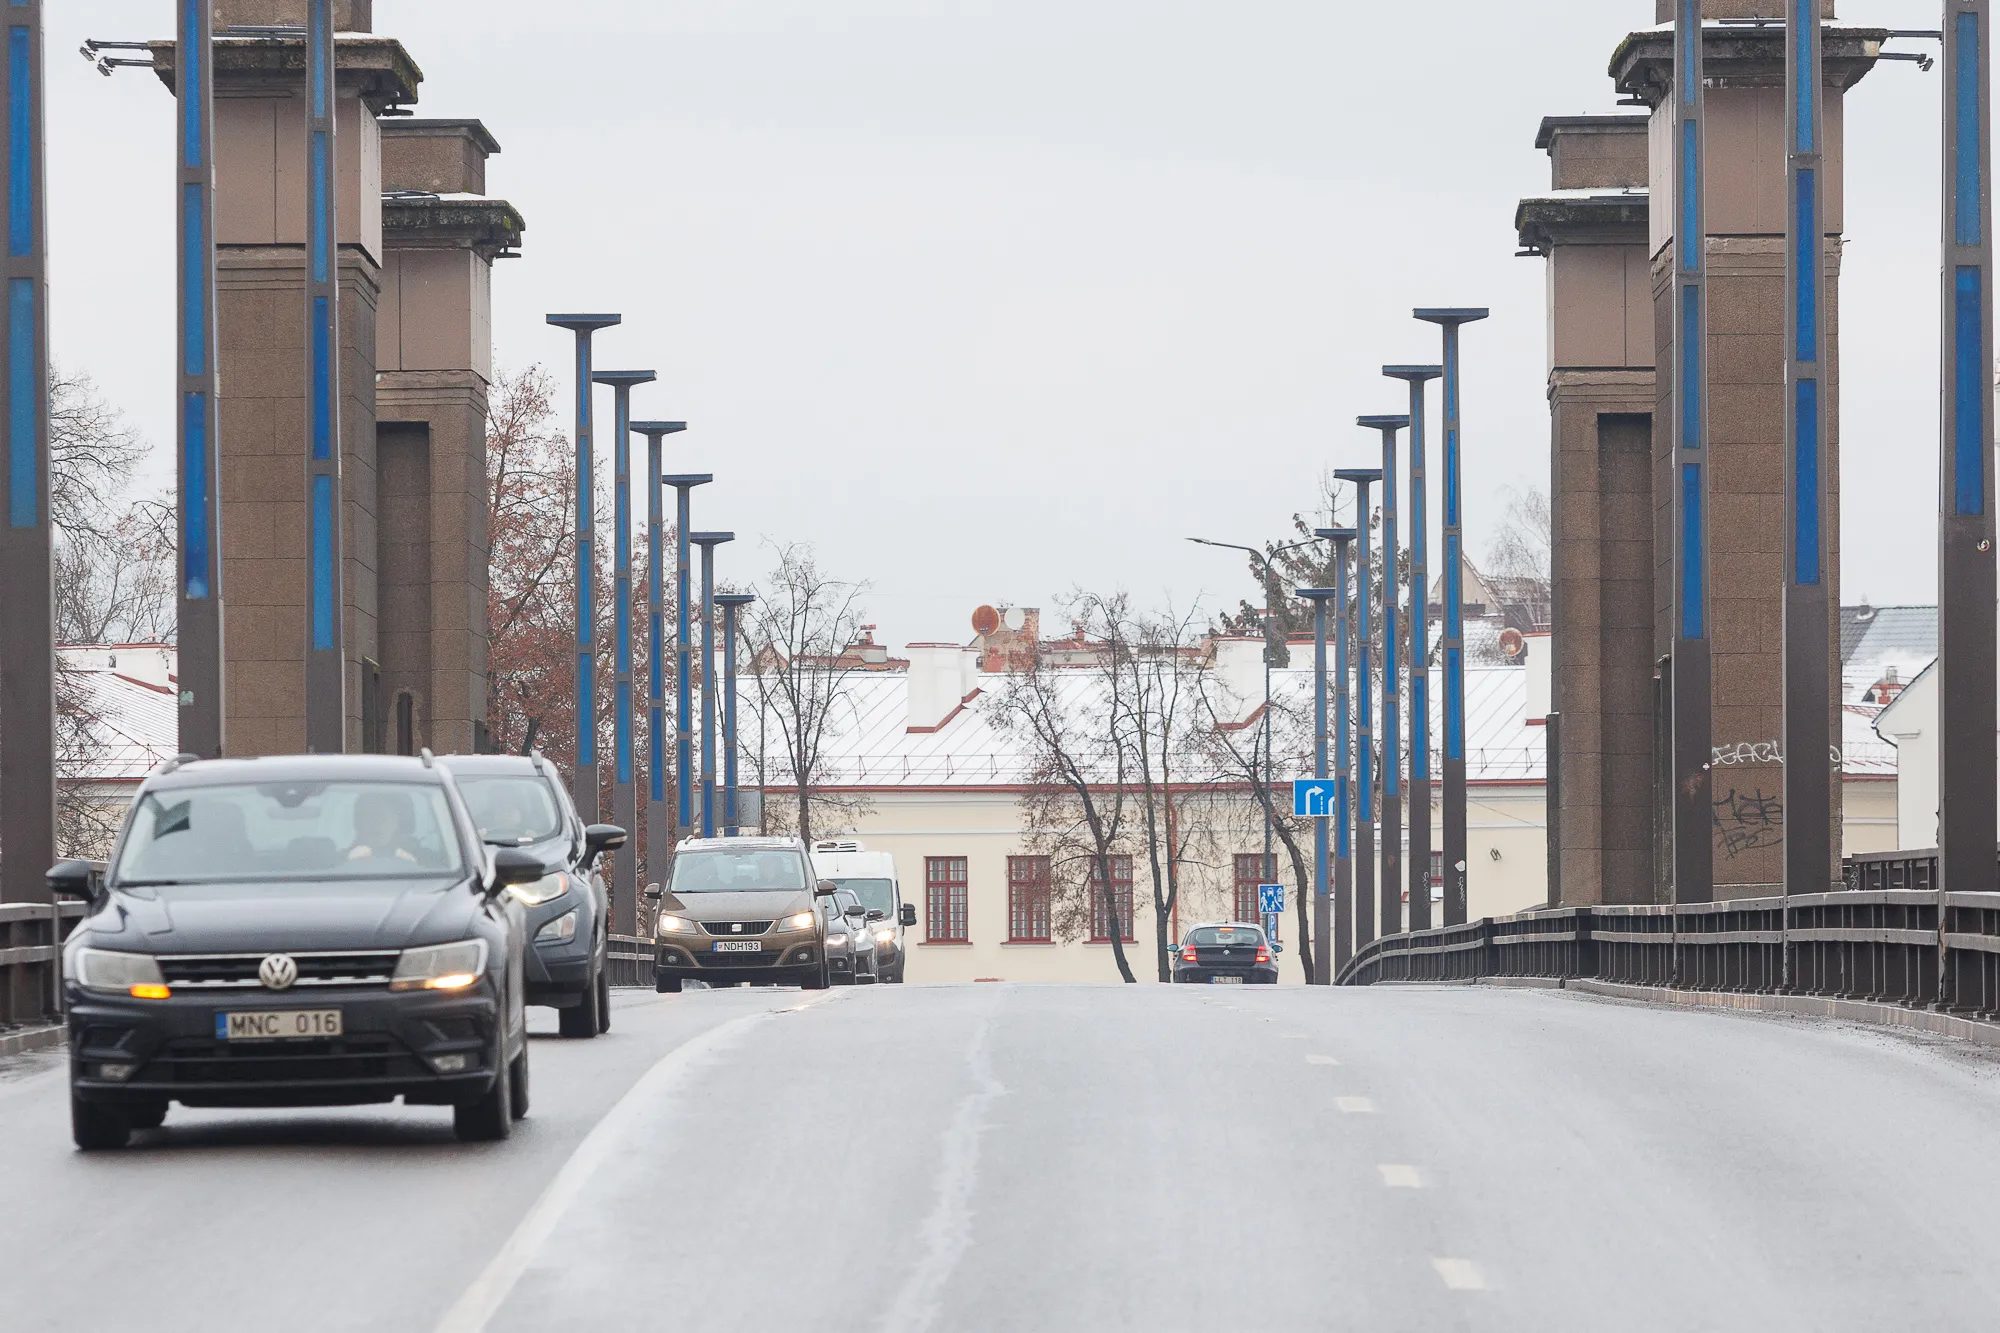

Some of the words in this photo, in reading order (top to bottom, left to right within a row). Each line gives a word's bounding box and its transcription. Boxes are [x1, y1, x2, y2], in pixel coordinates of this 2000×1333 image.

[723, 942, 759, 951] NDH193
[231, 1014, 280, 1035] MNC
[295, 1012, 337, 1034] 016
